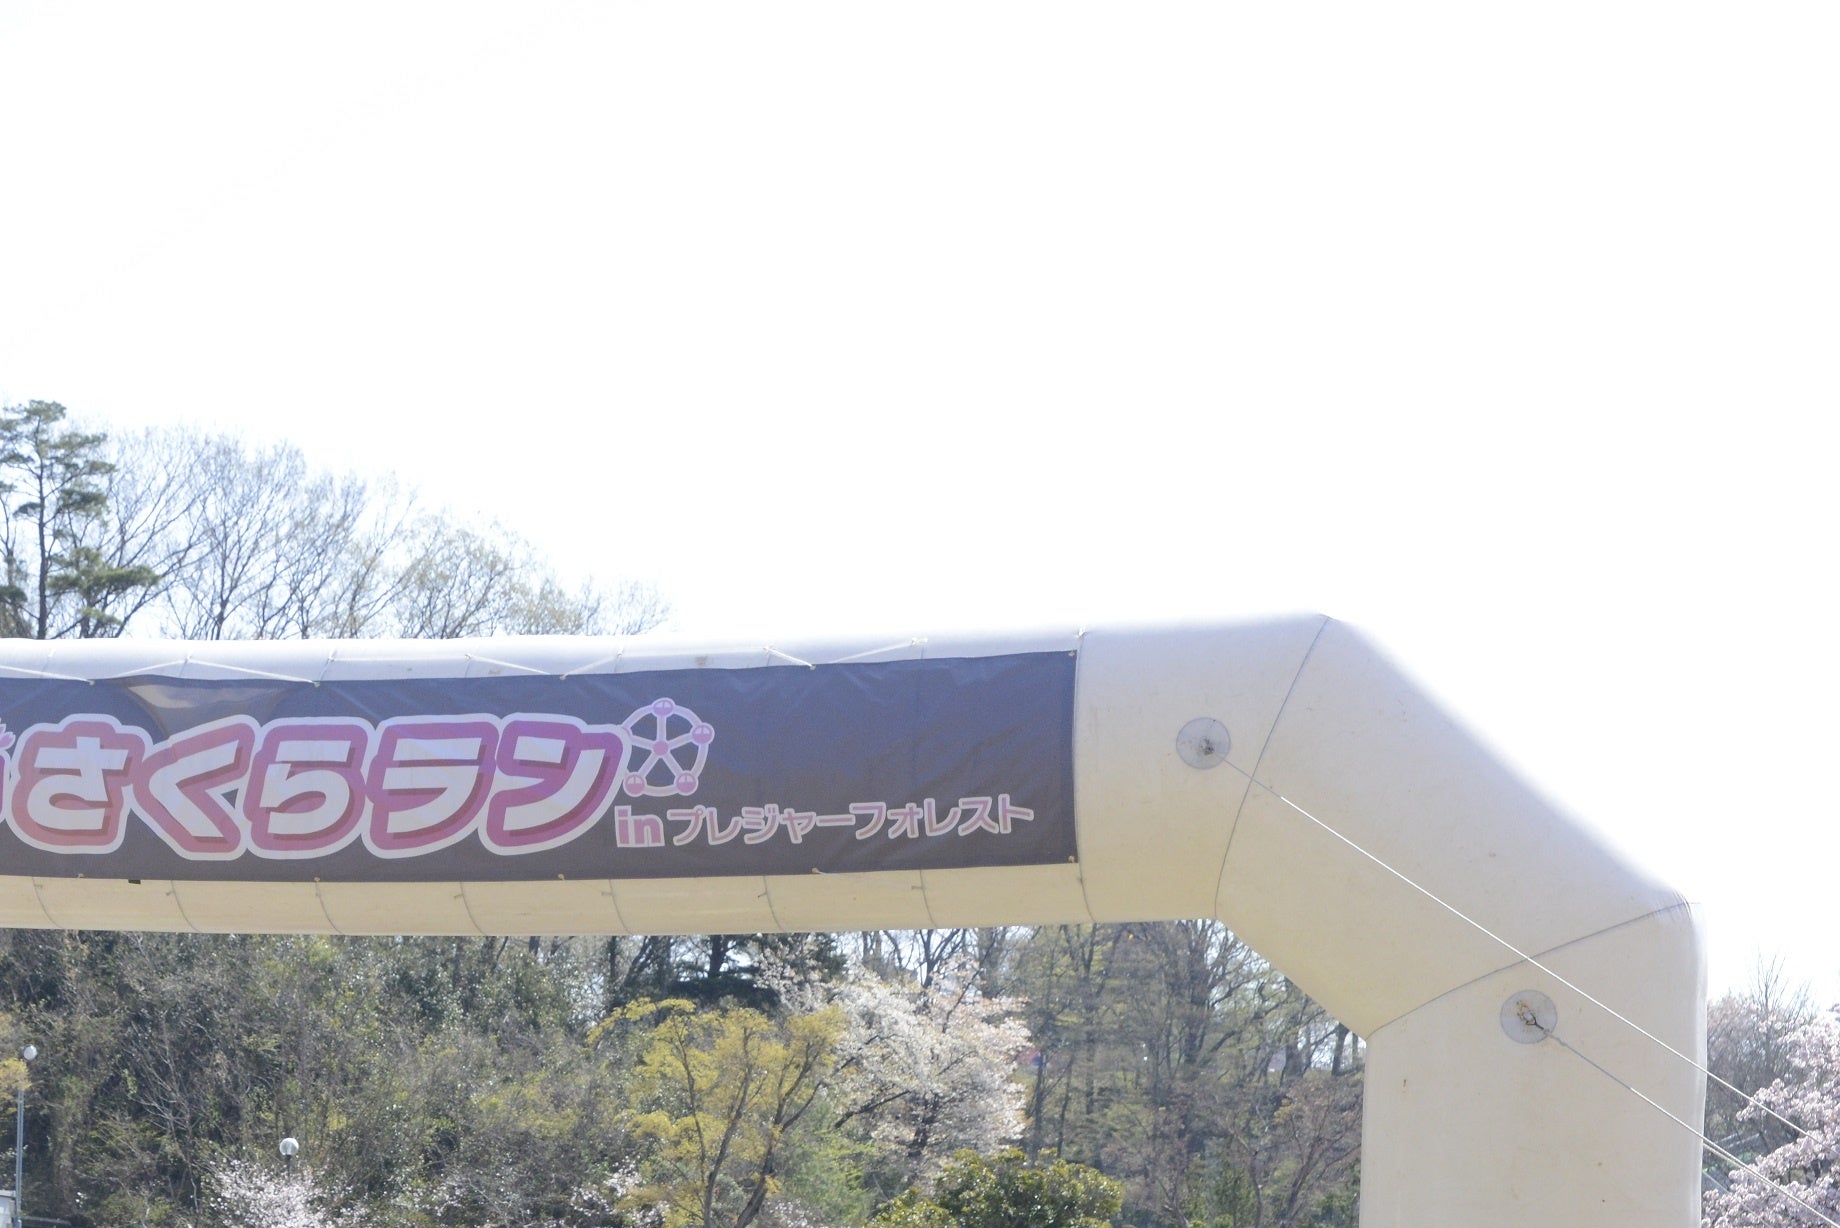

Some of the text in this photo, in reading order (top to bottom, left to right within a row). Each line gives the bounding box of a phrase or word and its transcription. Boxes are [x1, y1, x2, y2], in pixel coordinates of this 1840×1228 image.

[12, 720, 622, 854] さくらラン
[615, 794, 1035, 848] in プレジャーフォレスト
